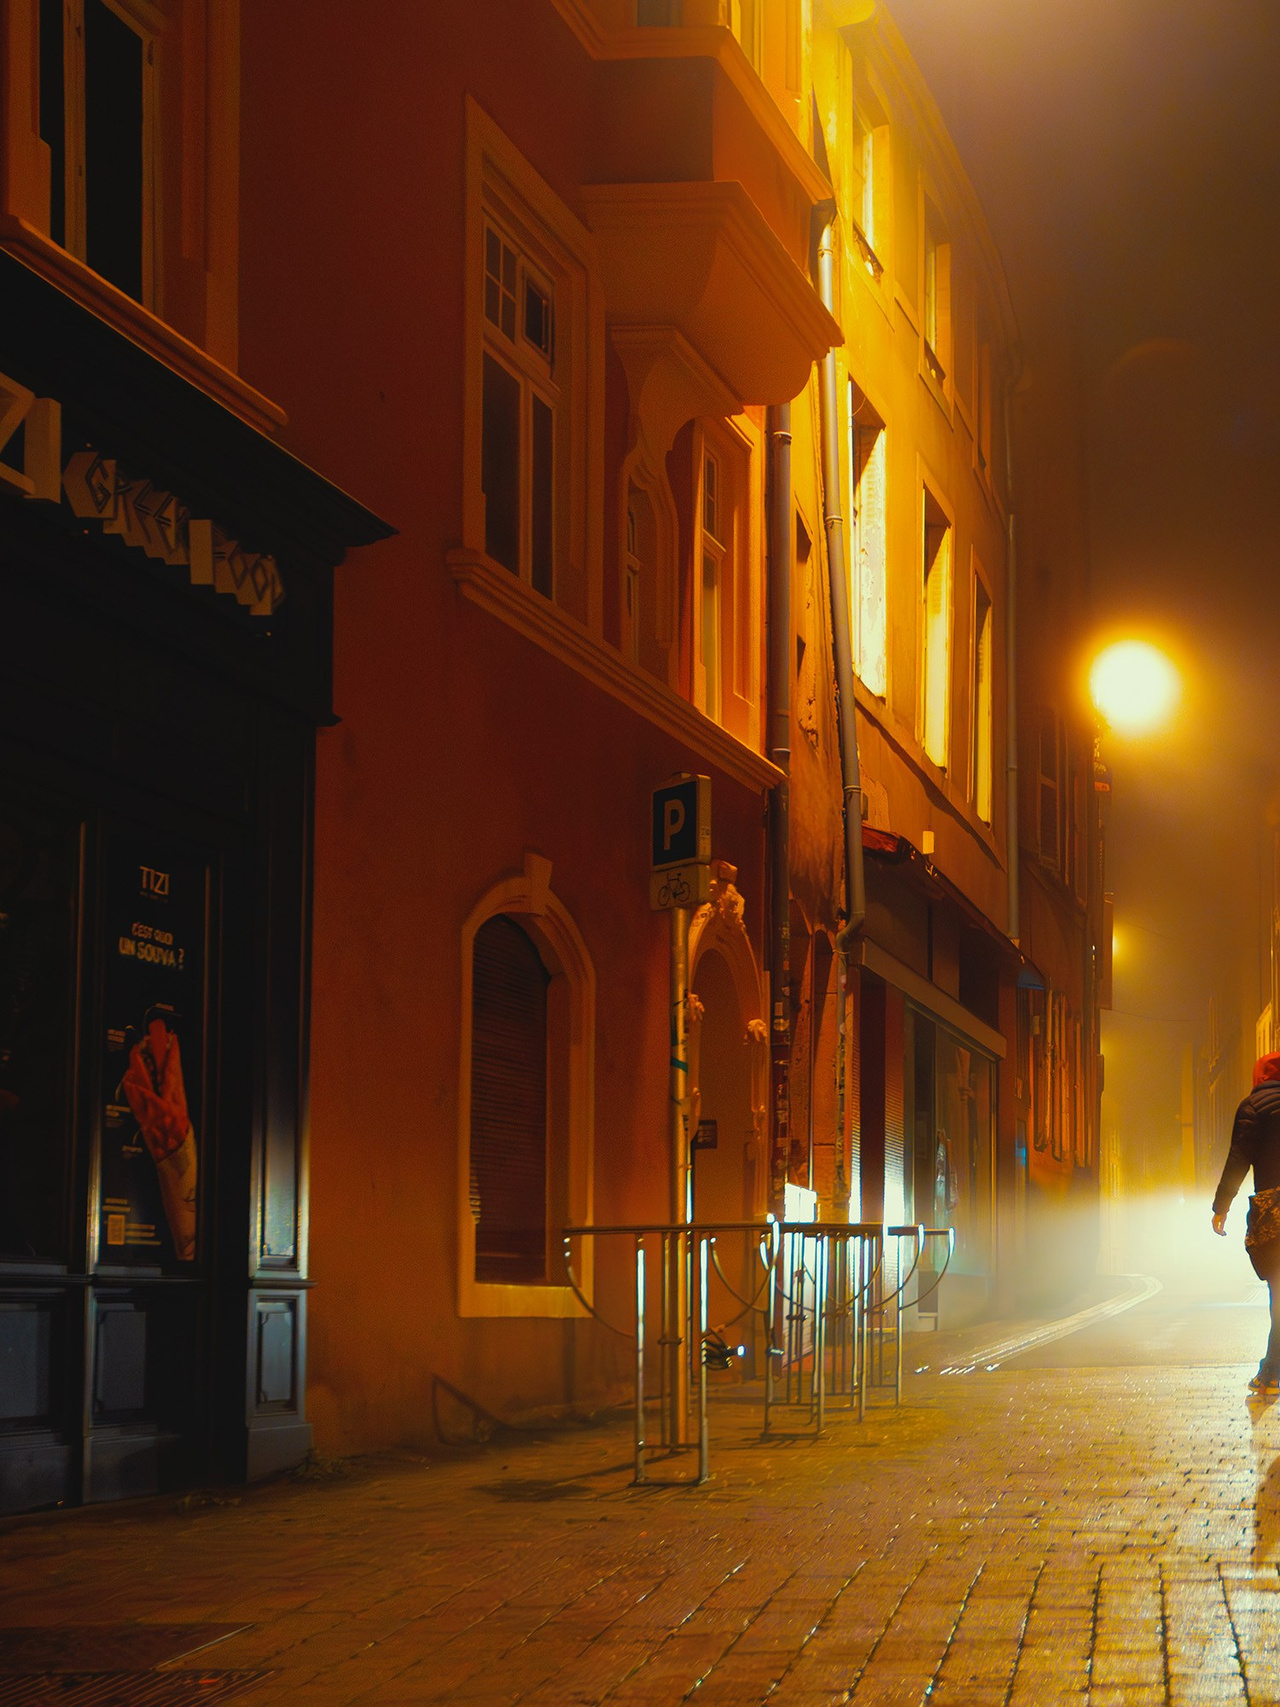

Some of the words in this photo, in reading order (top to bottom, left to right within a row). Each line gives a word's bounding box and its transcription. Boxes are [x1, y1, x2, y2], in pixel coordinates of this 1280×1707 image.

[664, 798, 686, 851] P
[139, 865, 170, 896] TIZI
[118, 936, 136, 956] UN
[177, 946, 185, 970] ?
